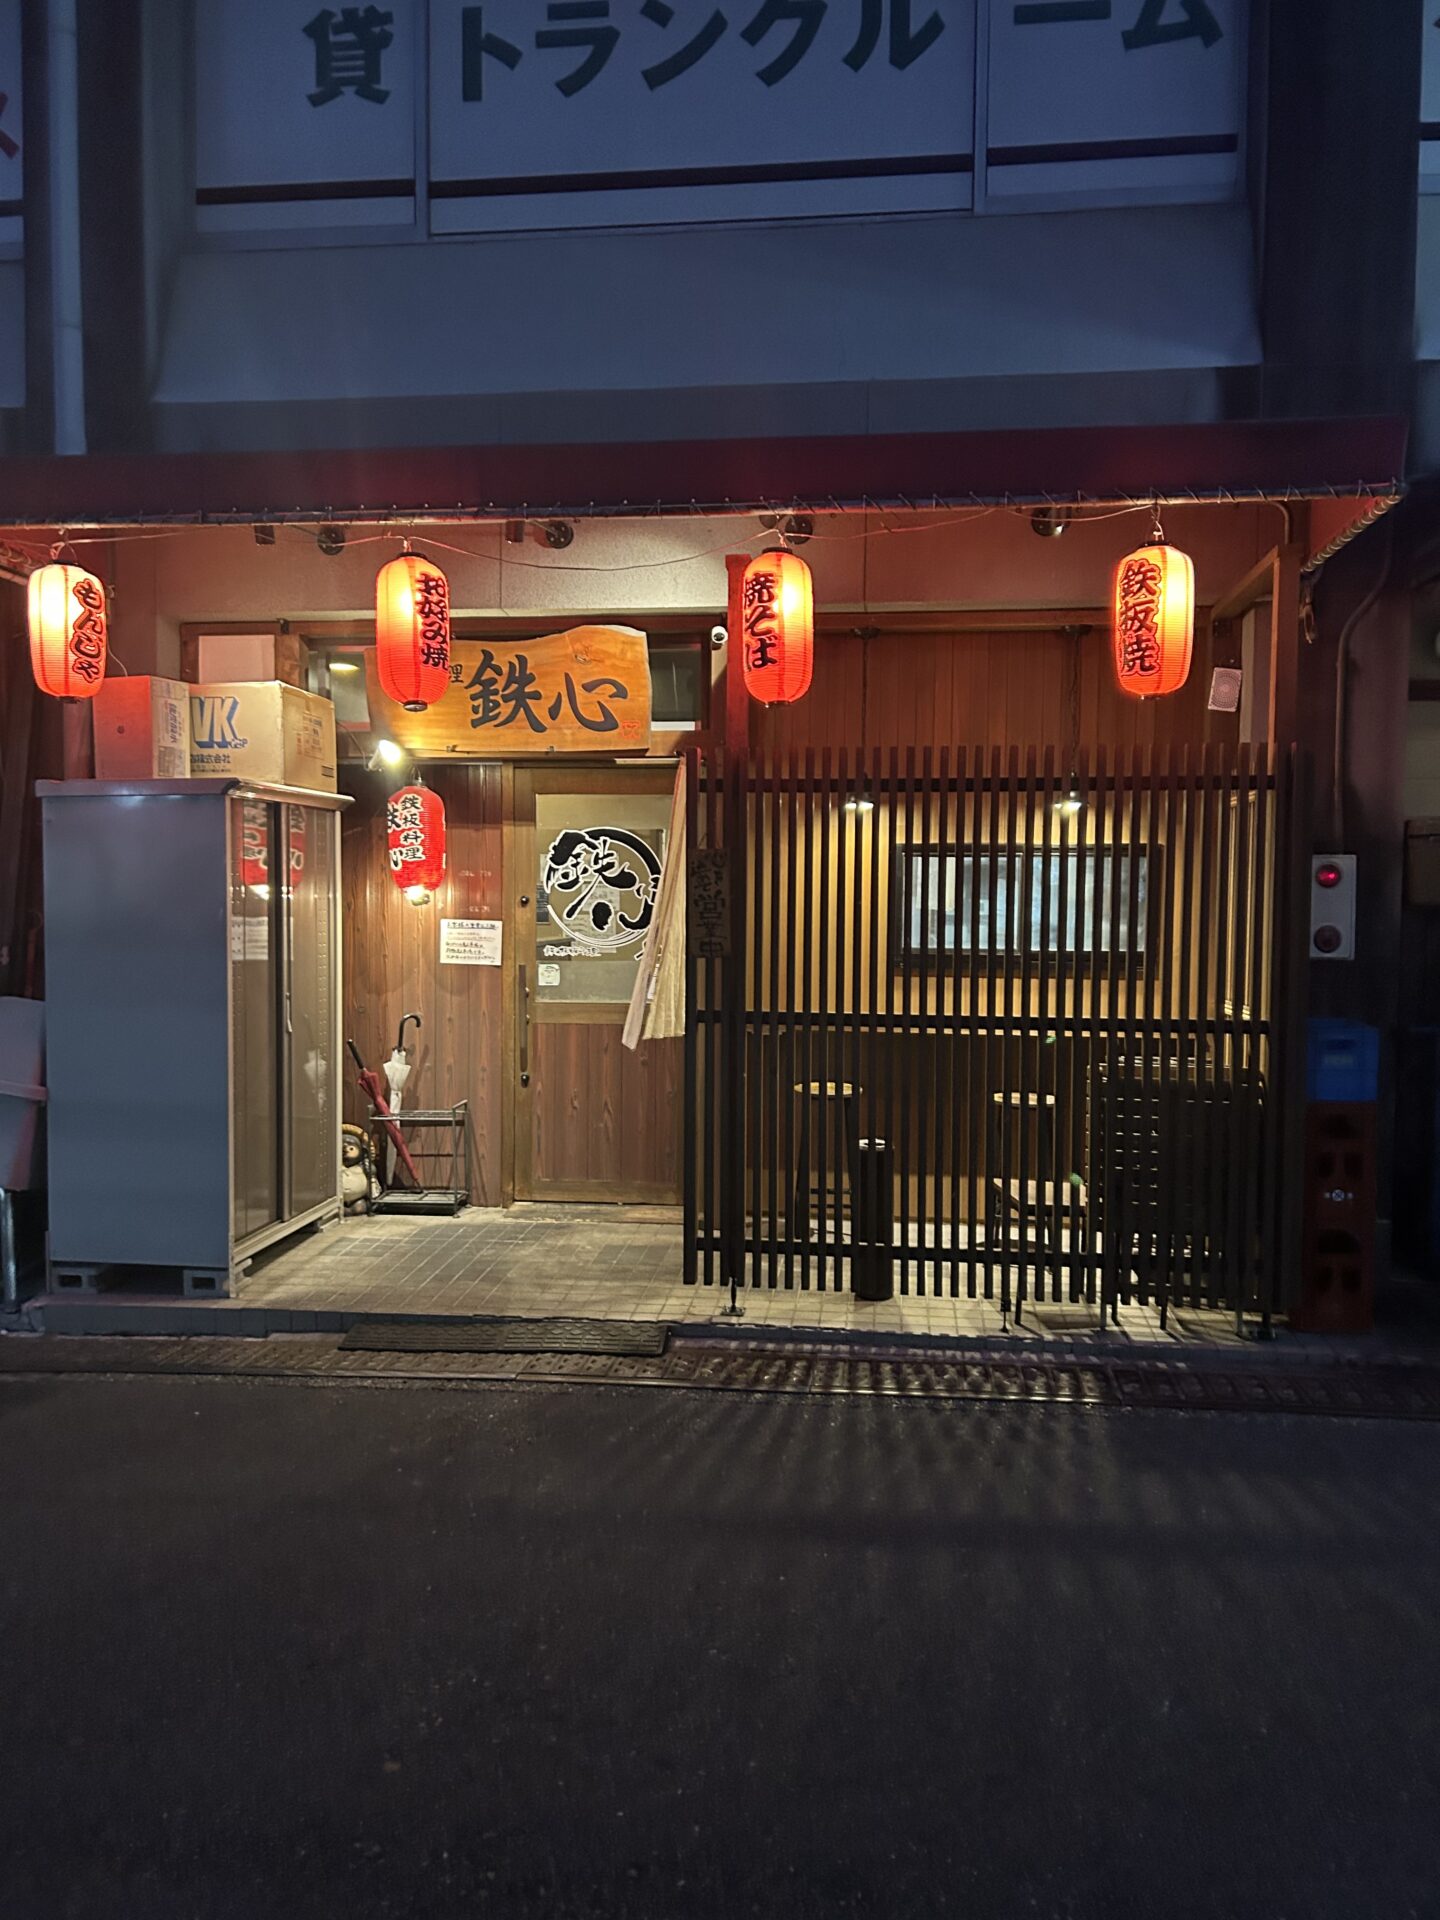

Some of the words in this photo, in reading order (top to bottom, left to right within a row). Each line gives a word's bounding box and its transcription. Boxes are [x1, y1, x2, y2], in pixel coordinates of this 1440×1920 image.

[71, 578, 105, 683] もんじゃ
[416, 573, 449, 670] お好み焼
[744, 572, 777, 672] 焼そば
[1121, 559, 1160, 676] 鉄板焼
[464, 648, 629, 734] 鉄心
[400, 794, 424, 861] 鉄板料理
